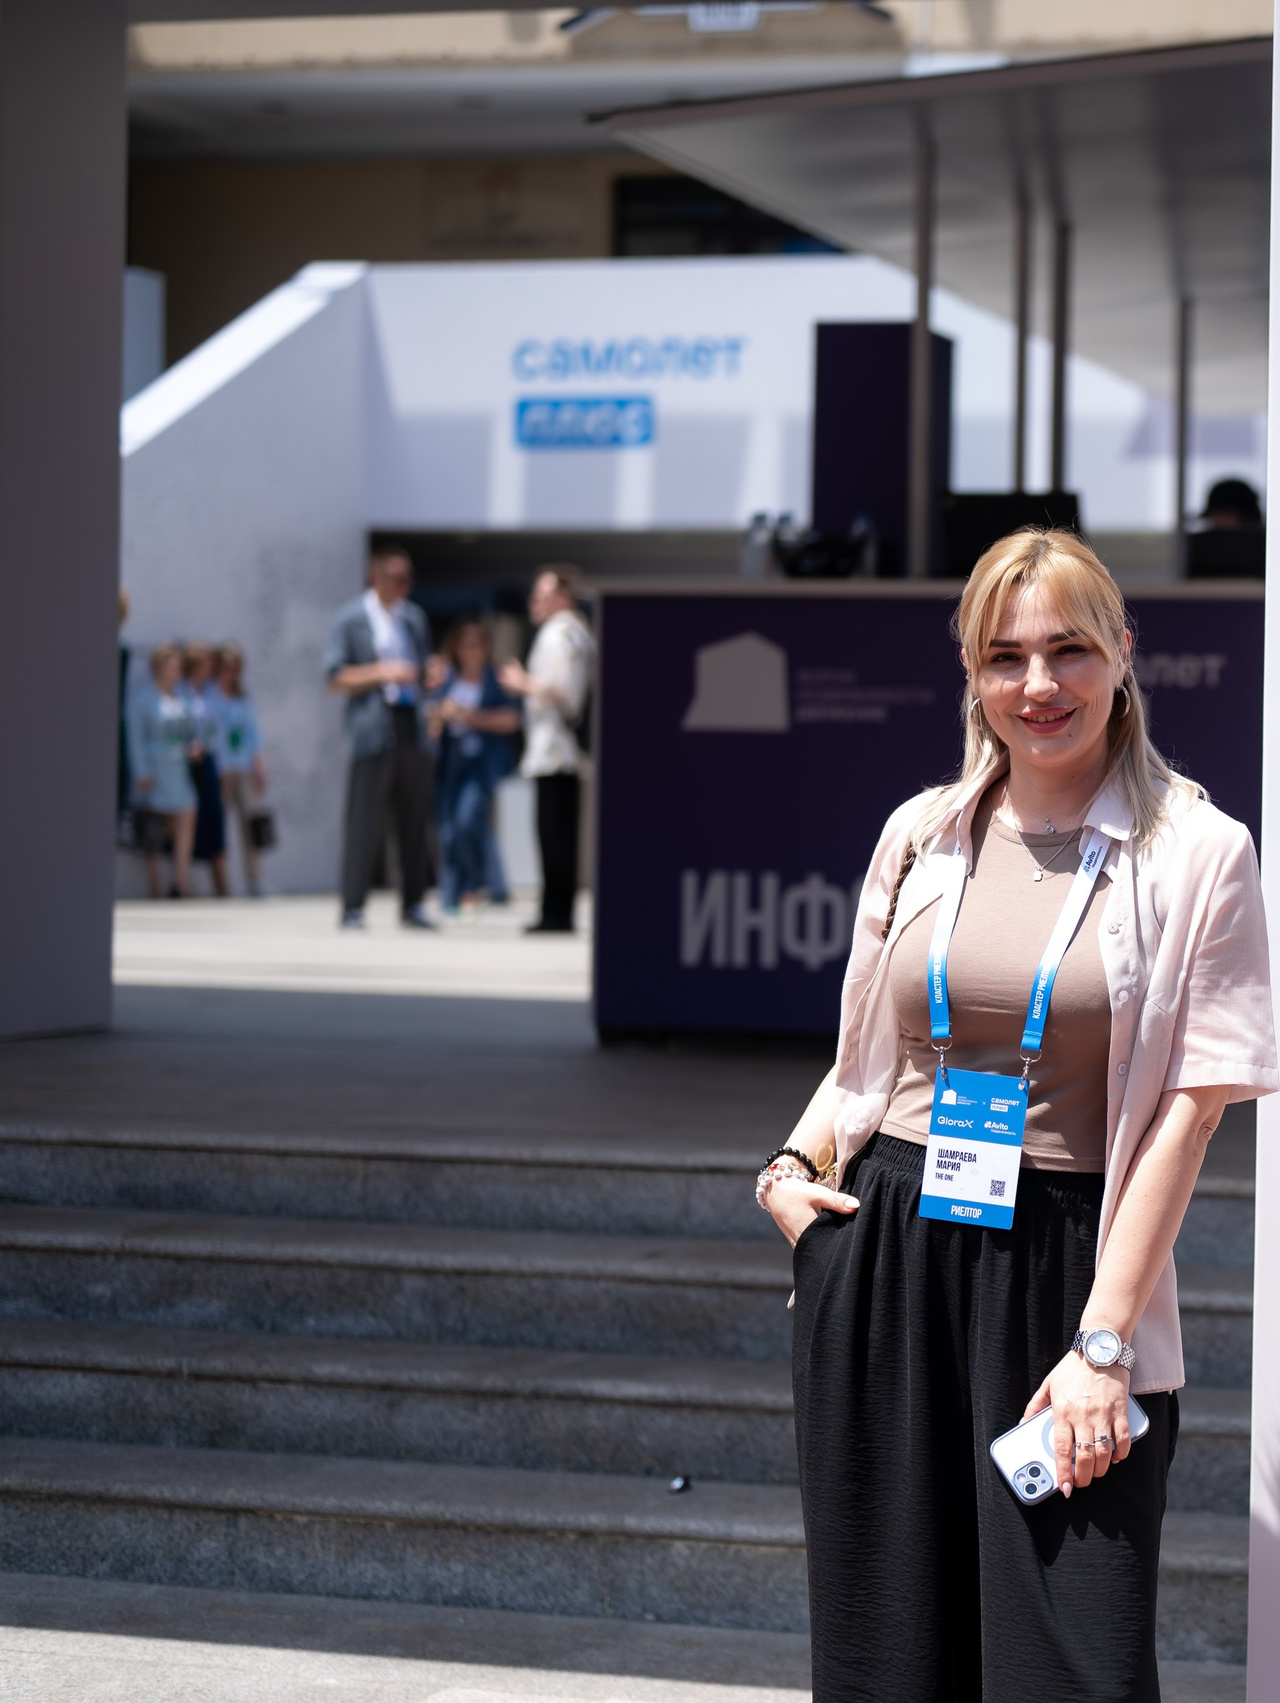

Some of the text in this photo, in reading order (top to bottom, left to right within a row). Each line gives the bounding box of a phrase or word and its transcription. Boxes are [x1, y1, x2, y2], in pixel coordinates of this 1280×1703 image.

[513, 336, 747, 382] самолет
[1085, 850, 1097, 867] Avito
[679, 868, 862, 972] ИНФ
[934, 975, 944, 1004] КЛАСТЕР
[1032, 990, 1044, 1019] КЛАСТЕР
[990, 1097, 1020, 1107] самолет
[937, 1115, 974, 1129] GloraX
[991, 1121, 1009, 1131] Avito
[937, 1148, 977, 1163] ШАМРАЕВА
[936, 1159, 961, 1172] МАРИЯ
[935, 1172, 954, 1182] THE ONE
[950, 1204, 983, 1219] РИЕЛТОР
